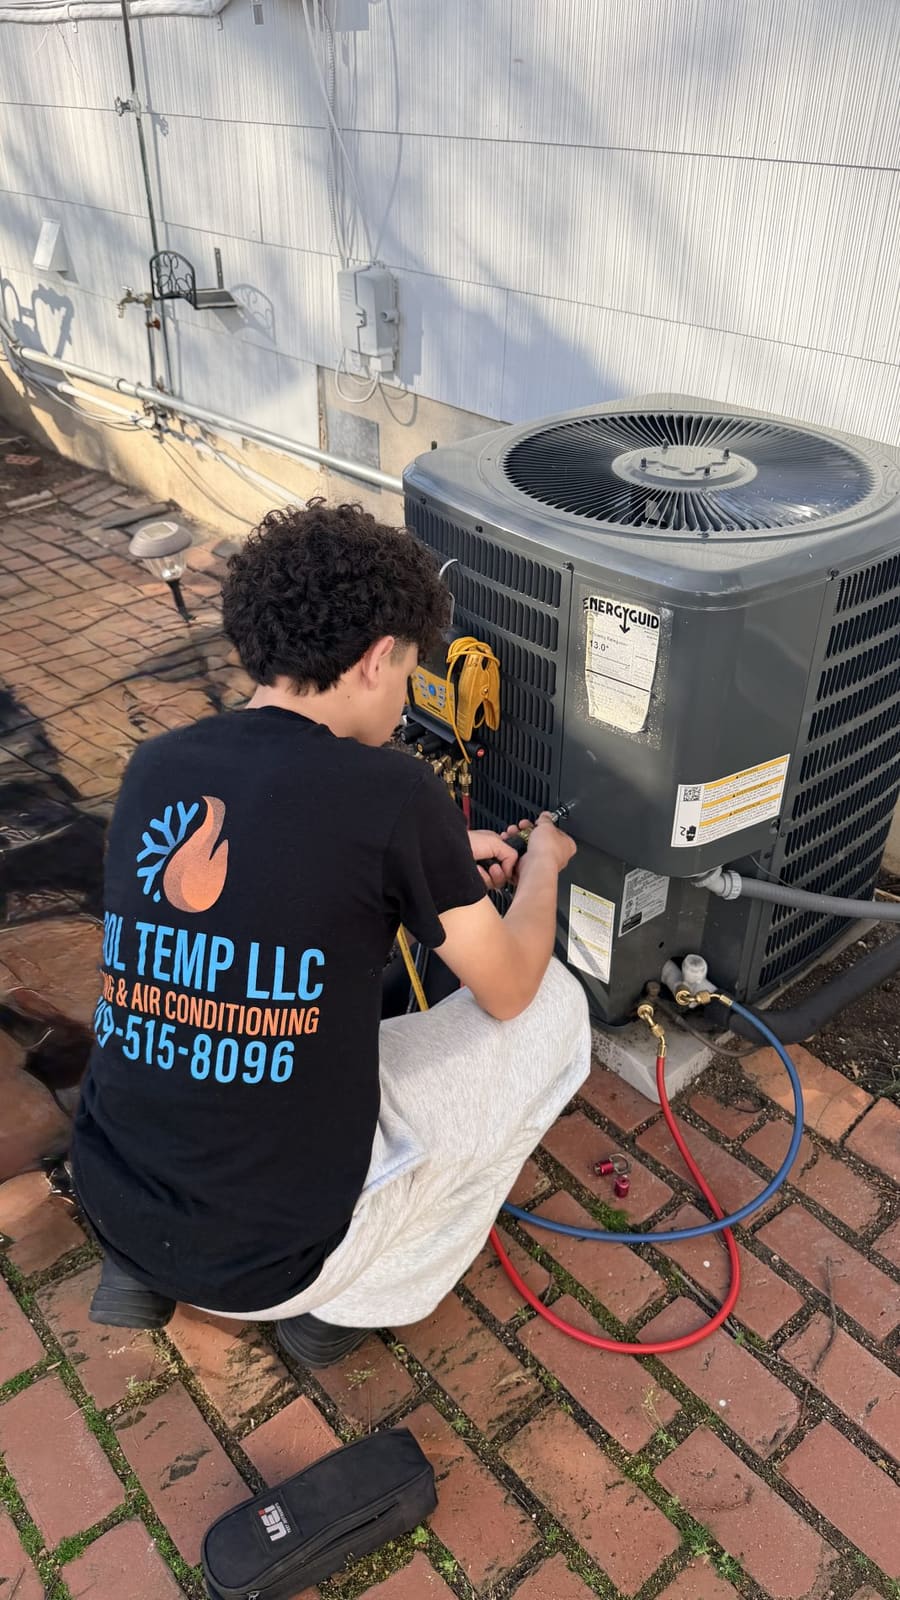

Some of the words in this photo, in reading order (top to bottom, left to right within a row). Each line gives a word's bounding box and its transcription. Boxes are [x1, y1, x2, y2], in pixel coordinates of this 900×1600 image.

[136, 921, 235, 992] TEMP
[246, 942, 325, 1001] LLC
[116, 978, 128, 1008] &
[131, 982, 161, 1016] AIR
[165, 990, 320, 1036] CONDITIONING
